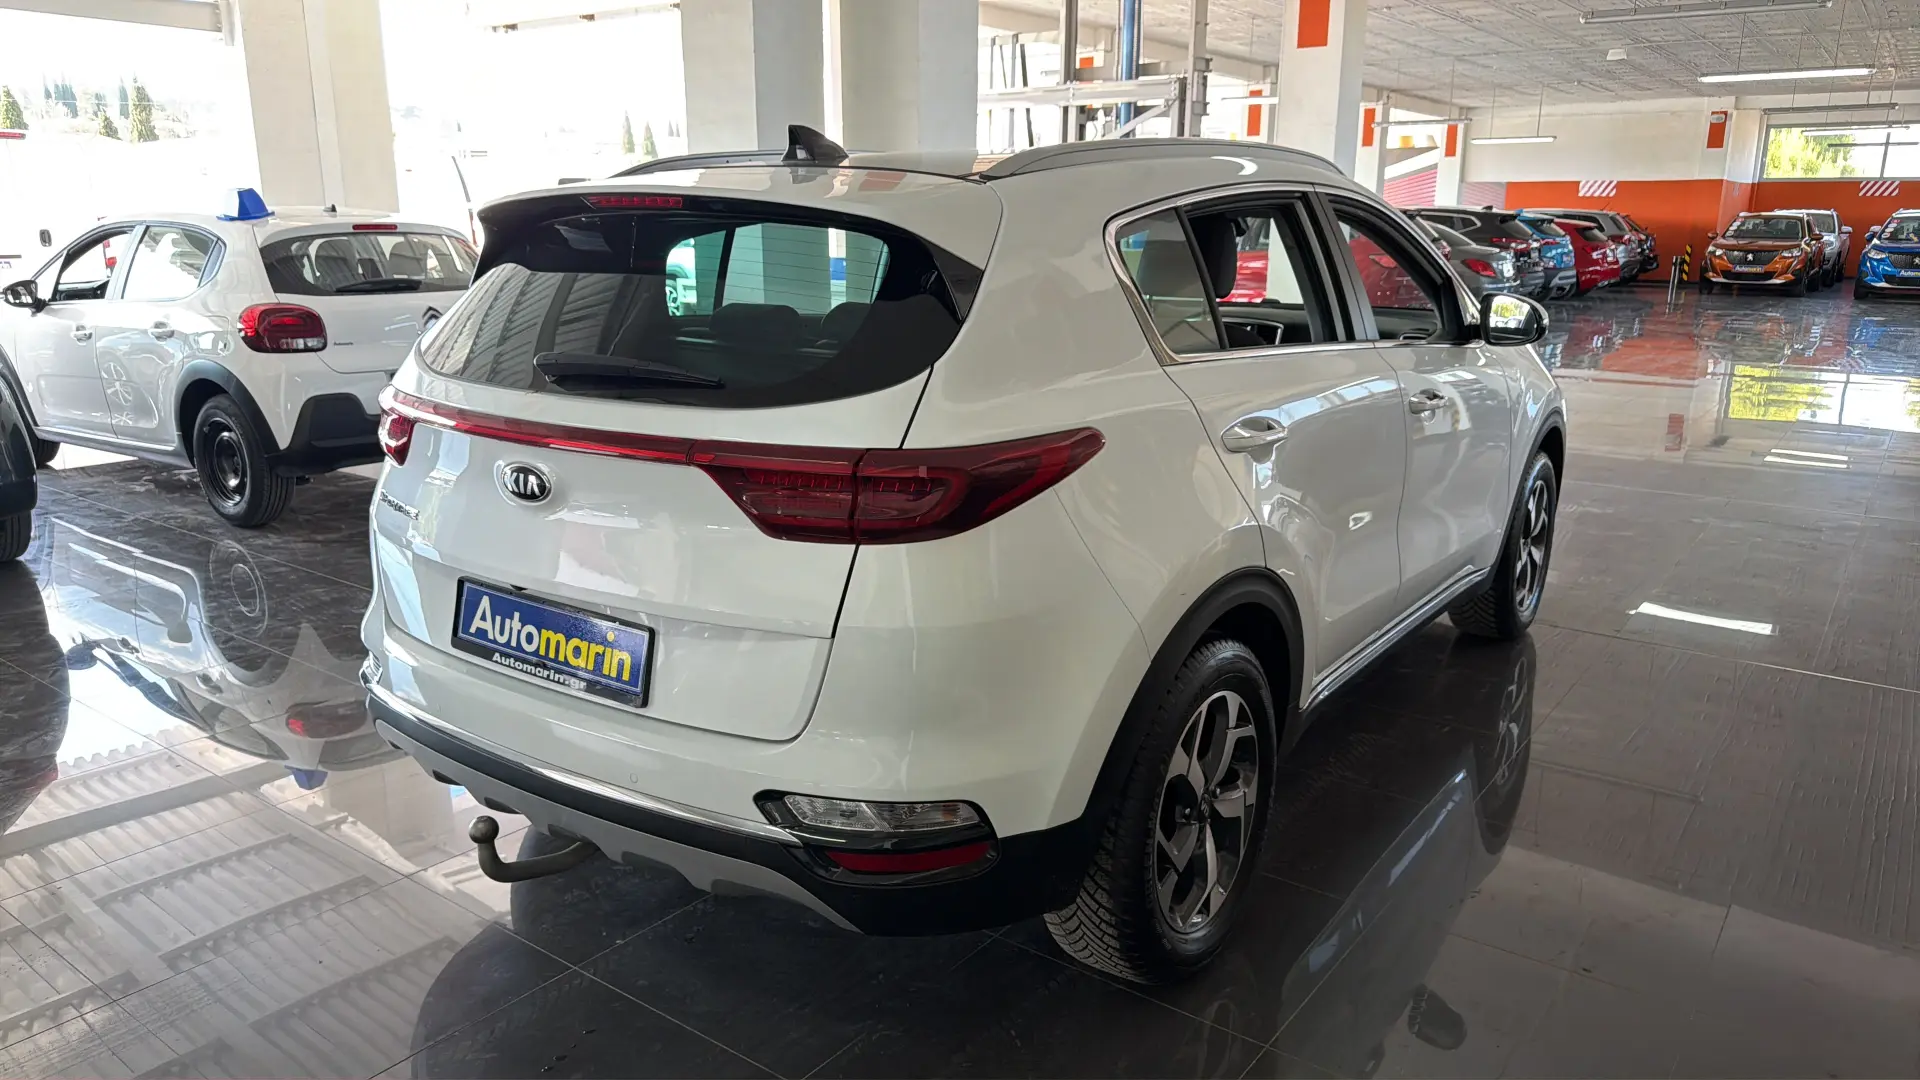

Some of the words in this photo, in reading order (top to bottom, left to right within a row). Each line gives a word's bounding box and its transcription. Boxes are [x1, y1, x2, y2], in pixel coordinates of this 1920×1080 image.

[504, 470, 541, 497] KIA
[468, 595, 632, 682] Automarin
[492, 653, 588, 690] Automarin.gr
